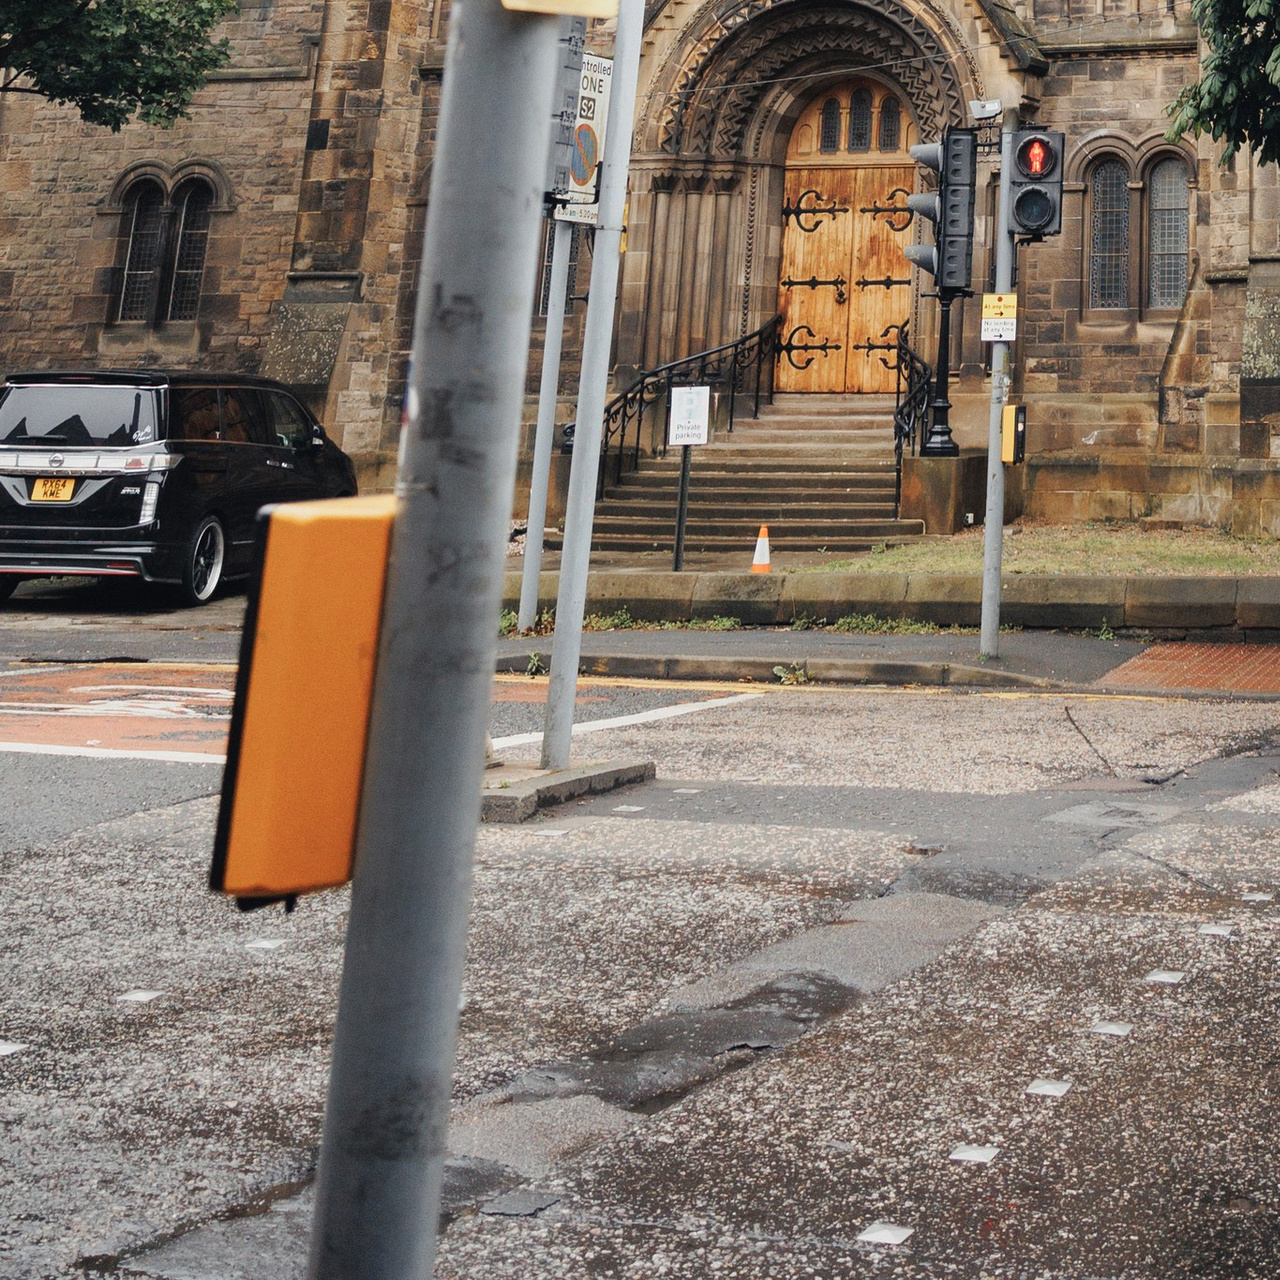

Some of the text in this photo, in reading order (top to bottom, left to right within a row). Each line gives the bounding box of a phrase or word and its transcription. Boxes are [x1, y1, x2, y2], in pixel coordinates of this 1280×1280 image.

[582, 60, 611, 76] ntrolled
[582, 75, 604, 94] ONE
[581, 99, 594, 117] S2
[675, 432, 702, 441] parking
